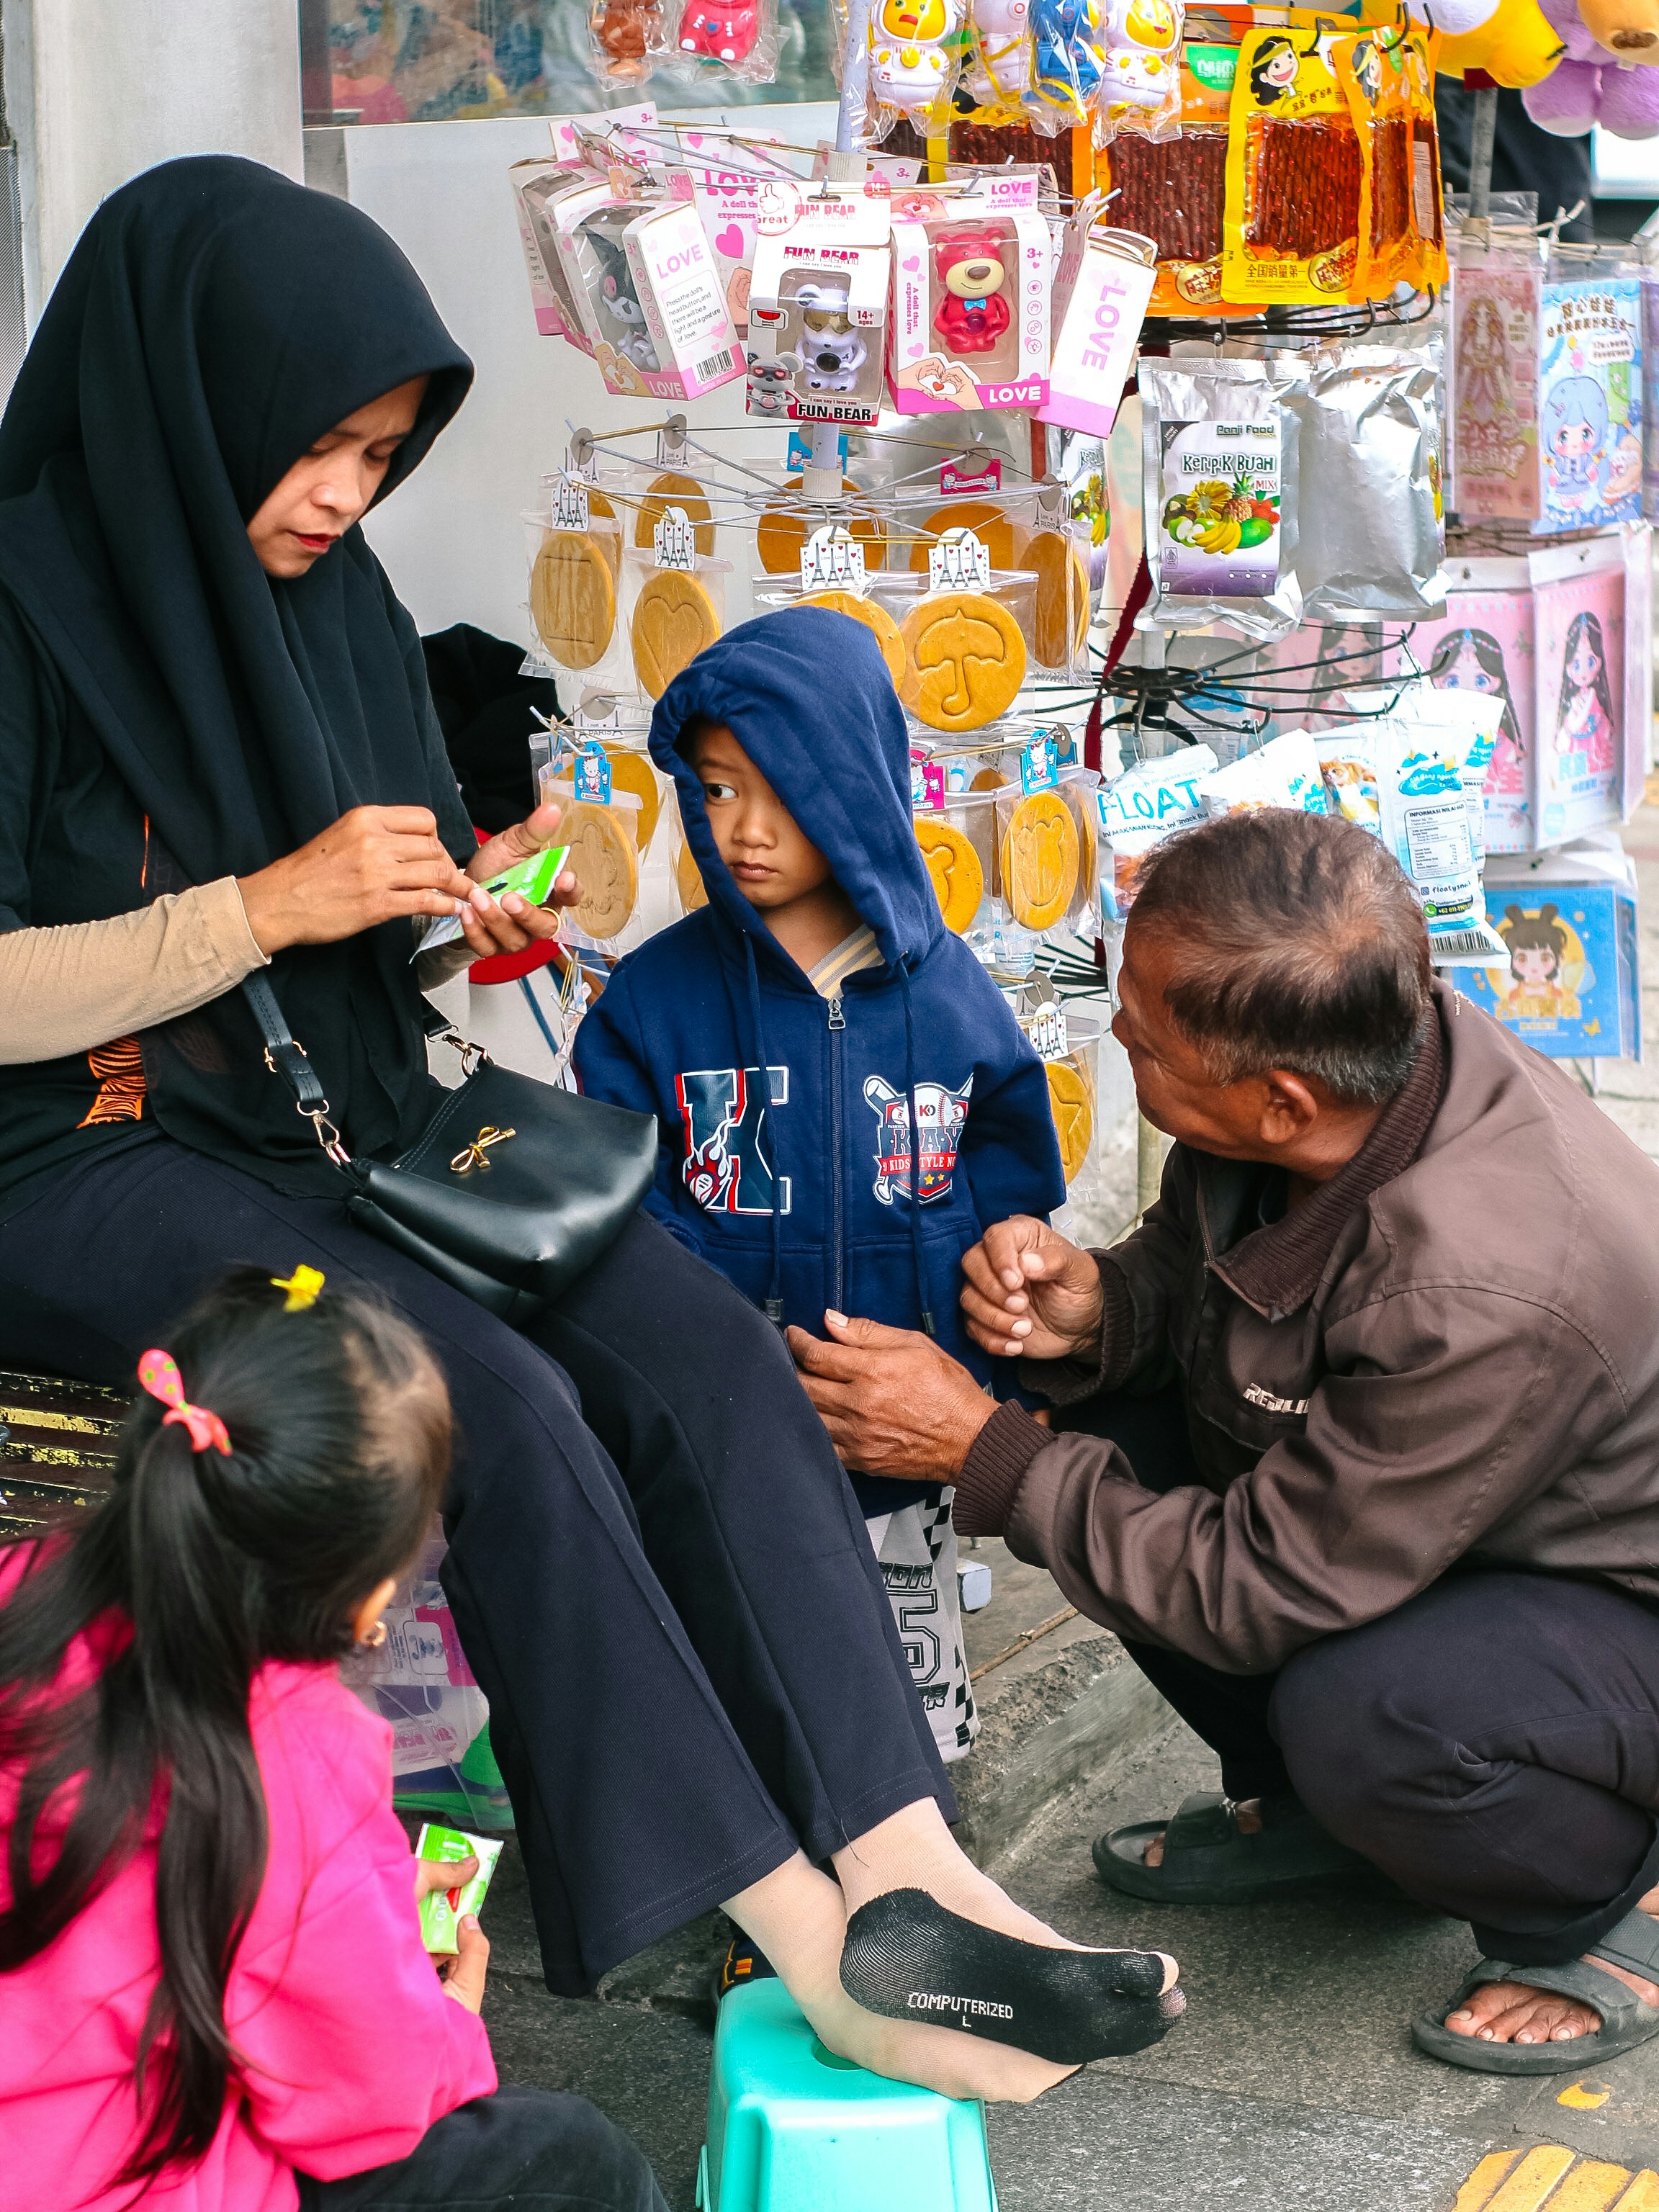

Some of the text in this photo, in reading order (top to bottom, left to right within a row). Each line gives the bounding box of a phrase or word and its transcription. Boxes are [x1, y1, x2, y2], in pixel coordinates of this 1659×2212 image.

[896, 167, 910, 179] 3+
[992, 182, 1032, 195] LOVE
[783, 246, 860, 265] FUN BEAR
[1027, 248, 1043, 258] 3+
[656, 243, 703, 279] LOVE
[857, 310, 874, 320] 14+
[1082, 284, 1127, 372] LOVE
[649, 380, 684, 397] LOVE
[989, 385, 1042, 404] LOVE
[798, 404, 871, 421] FUN BEAR
[1246, 425, 1274, 433] Food
[1254, 480, 1274, 491] MIX
[1040, 521, 1056, 530] PARIS
[1097, 779, 1200, 824] FLOAT
[1409, 809, 1441, 819] INFORMASI
[889, 1158, 911, 1172] KIDS
[919, 1156, 945, 1168] TYLE
[907, 1992, 1014, 2020] COMPUTERIZED
[962, 2015, 972, 2028] L
